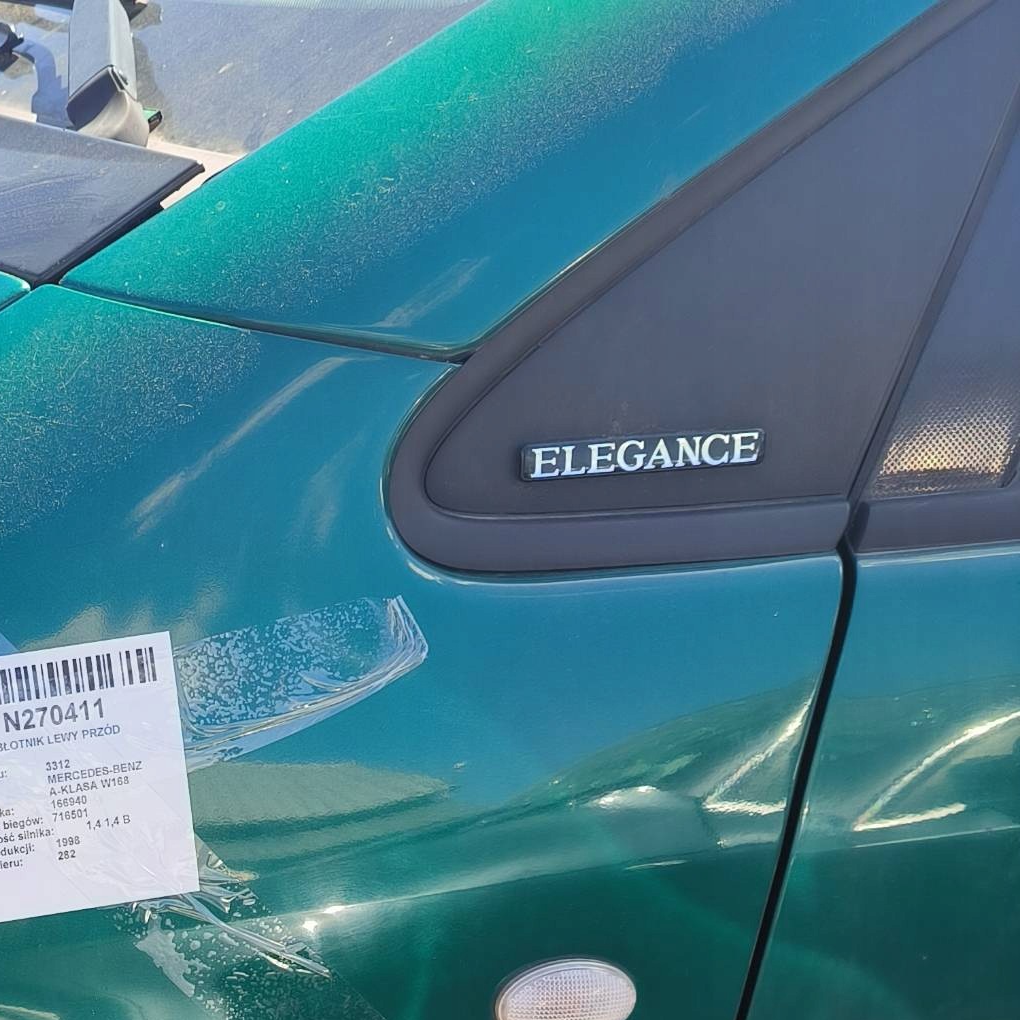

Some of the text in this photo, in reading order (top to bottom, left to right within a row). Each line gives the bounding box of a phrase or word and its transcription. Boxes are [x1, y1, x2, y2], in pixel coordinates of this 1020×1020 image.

[530, 431, 760, 478] ELEGANCE
[3, 697, 105, 733] N270411
[47, 731, 79, 745] LEWY
[82, 723, 121, 740] PRZÓD
[46, 759, 71, 772] 3312
[47, 760, 143, 784] MERCEDES-BENZ
[49, 780, 98, 797] A-KLASA
[100, 775, 130, 789] W168
[51, 795, 88, 809] 166940
[3, 817, 44, 830] biegów:
[52, 808, 88, 822] 716501
[18, 828, 55, 841] silnika:
[86, 819, 101, 831] 1,4
[104, 816, 120, 828] 1,4
[122, 814, 131, 825] B
[56, 835, 81, 848] 1998
[58, 849, 76, 861] 282
